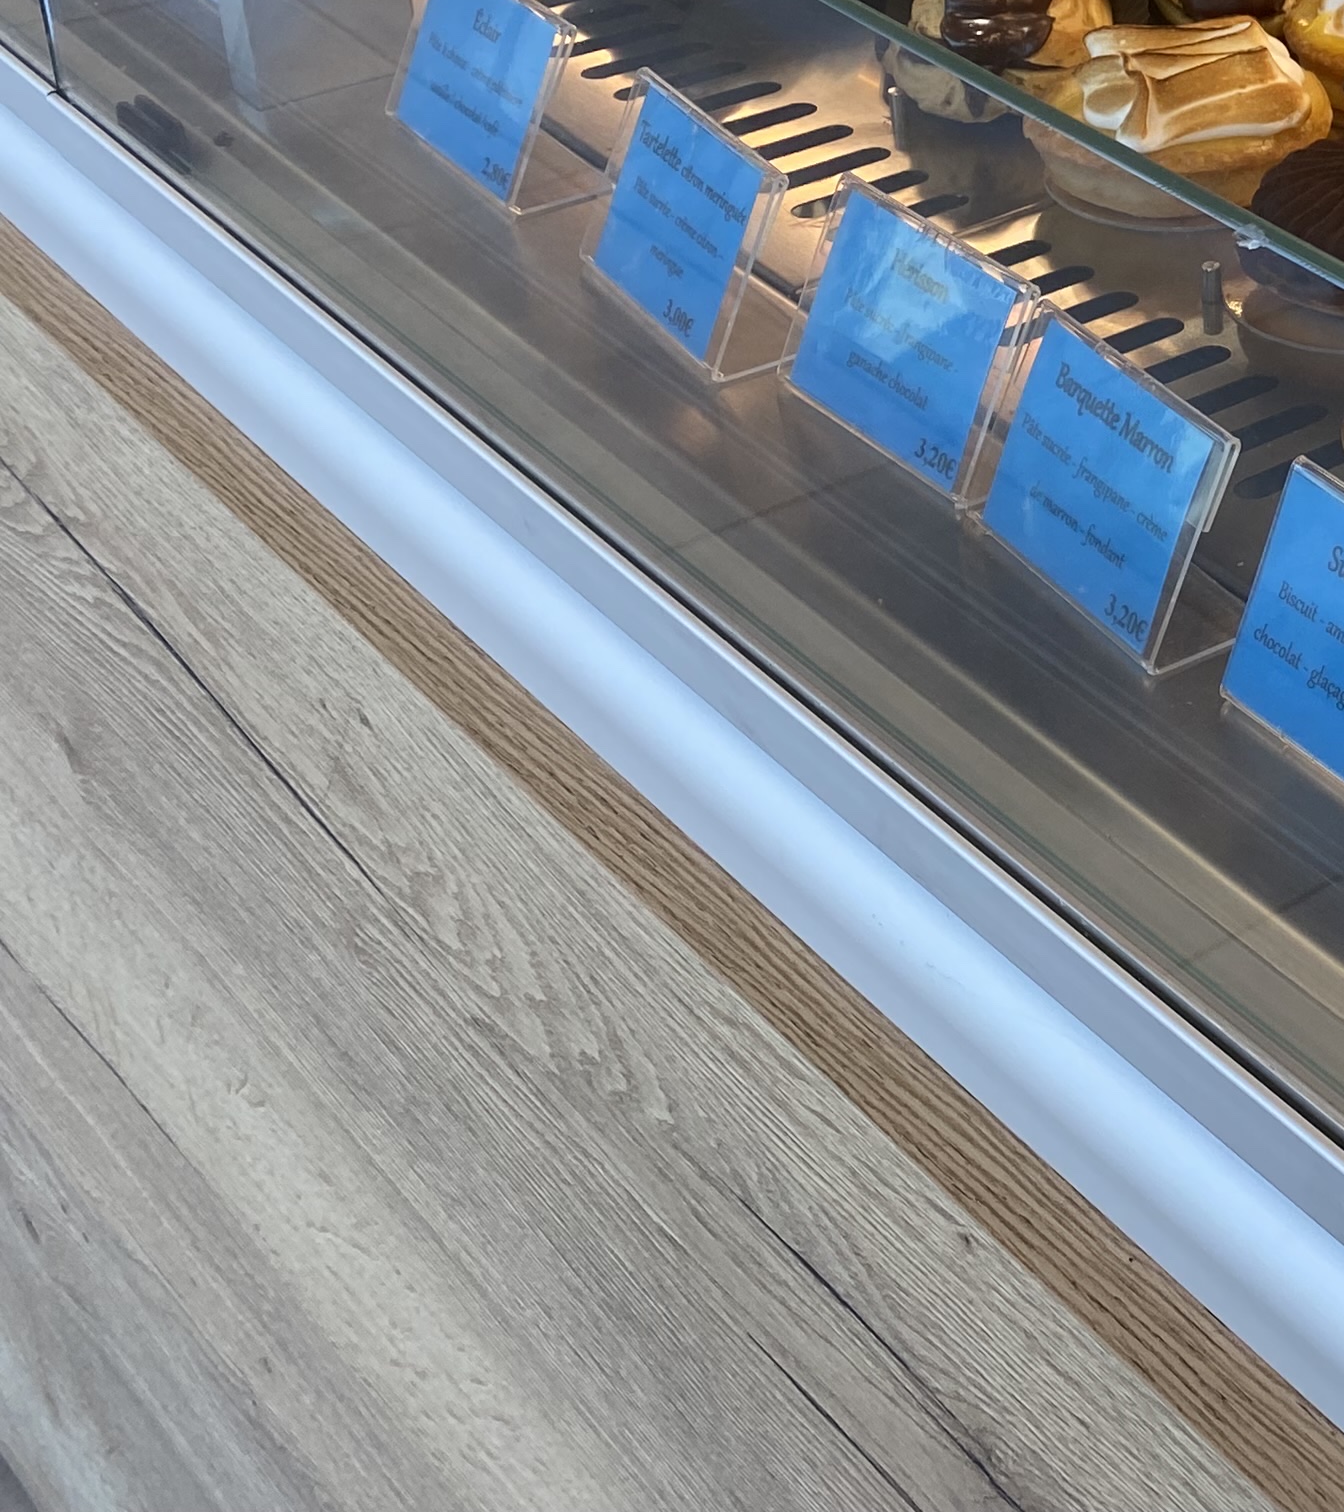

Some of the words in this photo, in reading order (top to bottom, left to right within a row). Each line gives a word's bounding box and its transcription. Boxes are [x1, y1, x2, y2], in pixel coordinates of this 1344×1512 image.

[639, 119, 682, 174] Tartelette
[681, 162, 704, 195] citron
[705, 184, 749, 228] meringuée
[846, 350, 889, 385] ganache
[888, 368, 929, 411] chocolat
[1055, 360, 1121, 431] Barquette
[1118, 410, 1174, 474] Marron
[914, 438, 957, 481] 3,20€
[1072, 456, 1132, 514] frangipane
[1136, 510, 1169, 543] crème
[1081, 524, 1128, 570] fondant
[1104, 593, 1149, 643] 3,20€
[1278, 580, 1318, 623] Biscuit
[1253, 623, 1303, 671] chocolat
